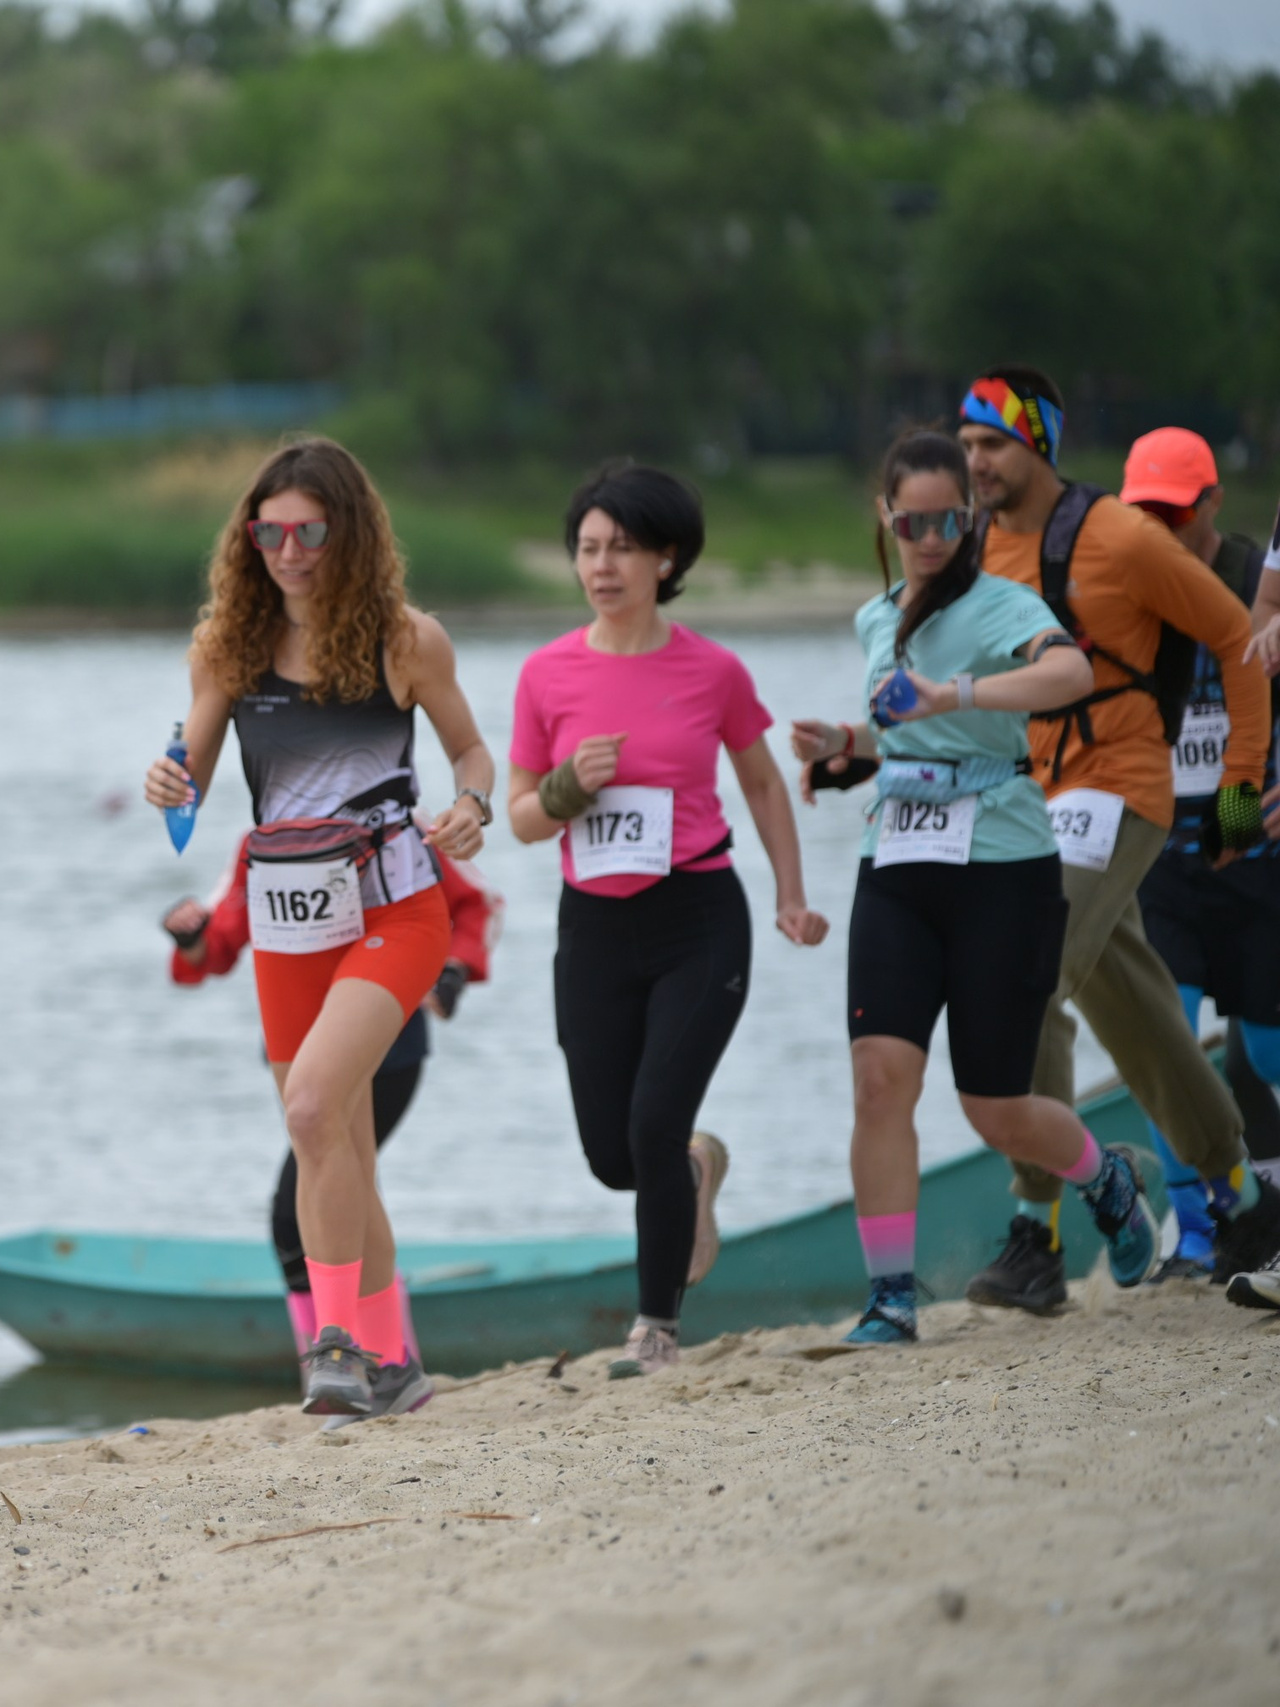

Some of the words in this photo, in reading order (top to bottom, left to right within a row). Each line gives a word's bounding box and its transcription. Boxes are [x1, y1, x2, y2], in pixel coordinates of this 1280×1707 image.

[1176, 738, 1227, 767] 108
[586, 810, 645, 845] 1173
[266, 888, 335, 922] 1162
